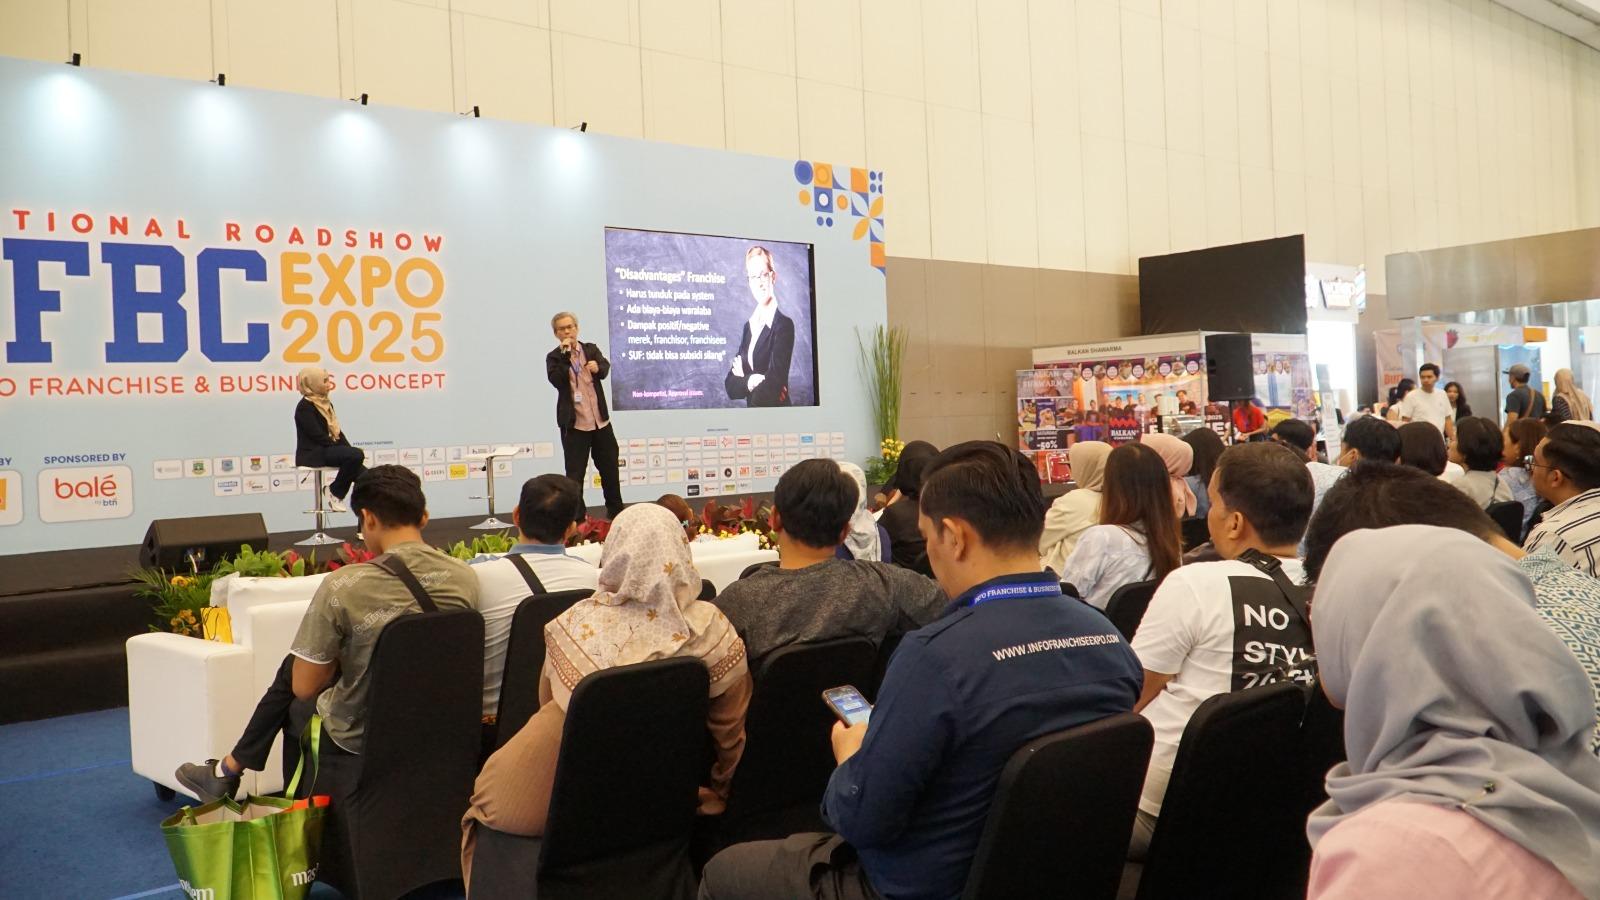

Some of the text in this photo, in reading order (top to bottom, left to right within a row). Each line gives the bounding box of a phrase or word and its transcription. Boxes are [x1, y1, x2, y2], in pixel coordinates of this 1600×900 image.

[12, 209, 443, 252] TIONAL ROADSHOW
[280, 250, 445, 308] EXPO
[687, 271, 726, 284] Franchise
[2, 237, 271, 363] FBC
[626, 288, 715, 302] Harus tunduk pada system
[627, 304, 641, 314] Ada
[681, 306, 712, 316] waralaba
[627, 320, 657, 332] Dampak
[281, 309, 445, 363] 2025
[628, 334, 727, 345] merek, franchisor, franchisees
[646, 350, 664, 360] tidak
[664, 350, 679, 360] bisa
[679, 350, 703, 360] subsidi
[1090, 345, 1122, 354] SHAWARMA
[29, 376, 184, 396] FRANCHISE
[194, 376, 211, 393] &
[220, 373, 336, 392] BUSINS
[345, 373, 446, 391] CONCEPT
[44, 453, 126, 465] SPONSORED BY
[55, 474, 117, 499] balé
[987, 586, 1027, 598] FRANCHISE
[1243, 603, 1290, 631] NO
[1243, 641, 1316, 666] STYL
